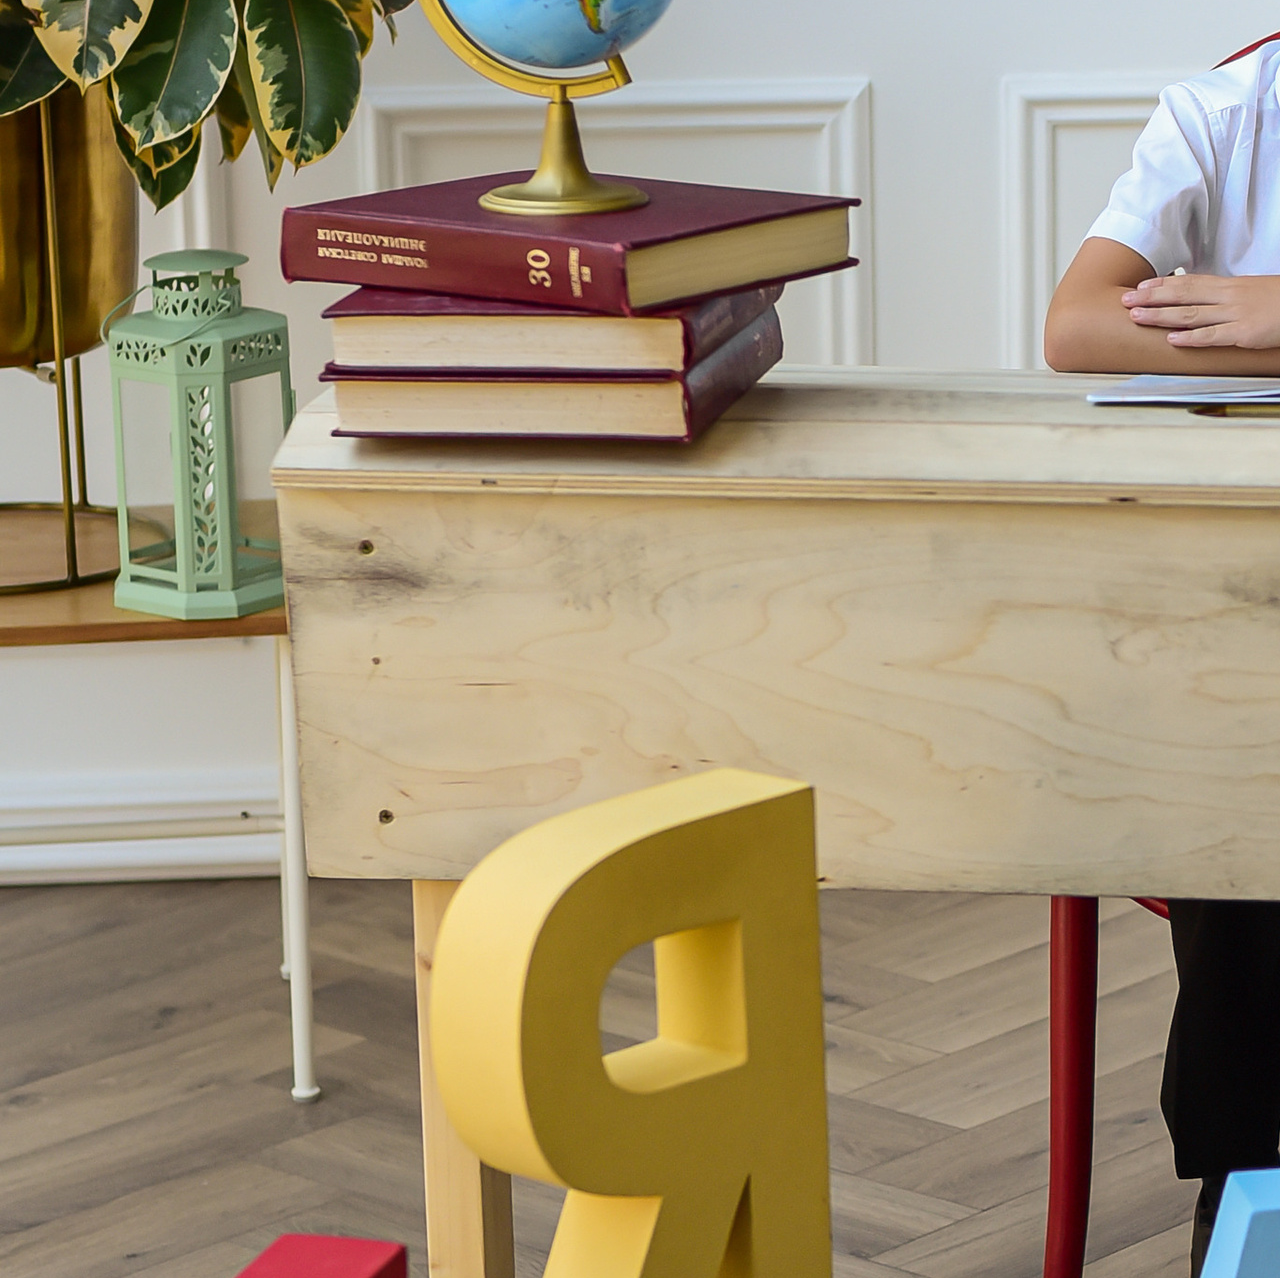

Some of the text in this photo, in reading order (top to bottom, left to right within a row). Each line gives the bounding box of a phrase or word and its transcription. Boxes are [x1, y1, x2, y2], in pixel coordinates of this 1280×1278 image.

[316, 228, 427, 252] ЭНЦИКЛОПЕДИЯ
[317, 247, 378, 263] СОВЕТСКАЯ
[526, 248, 552, 288] 30
